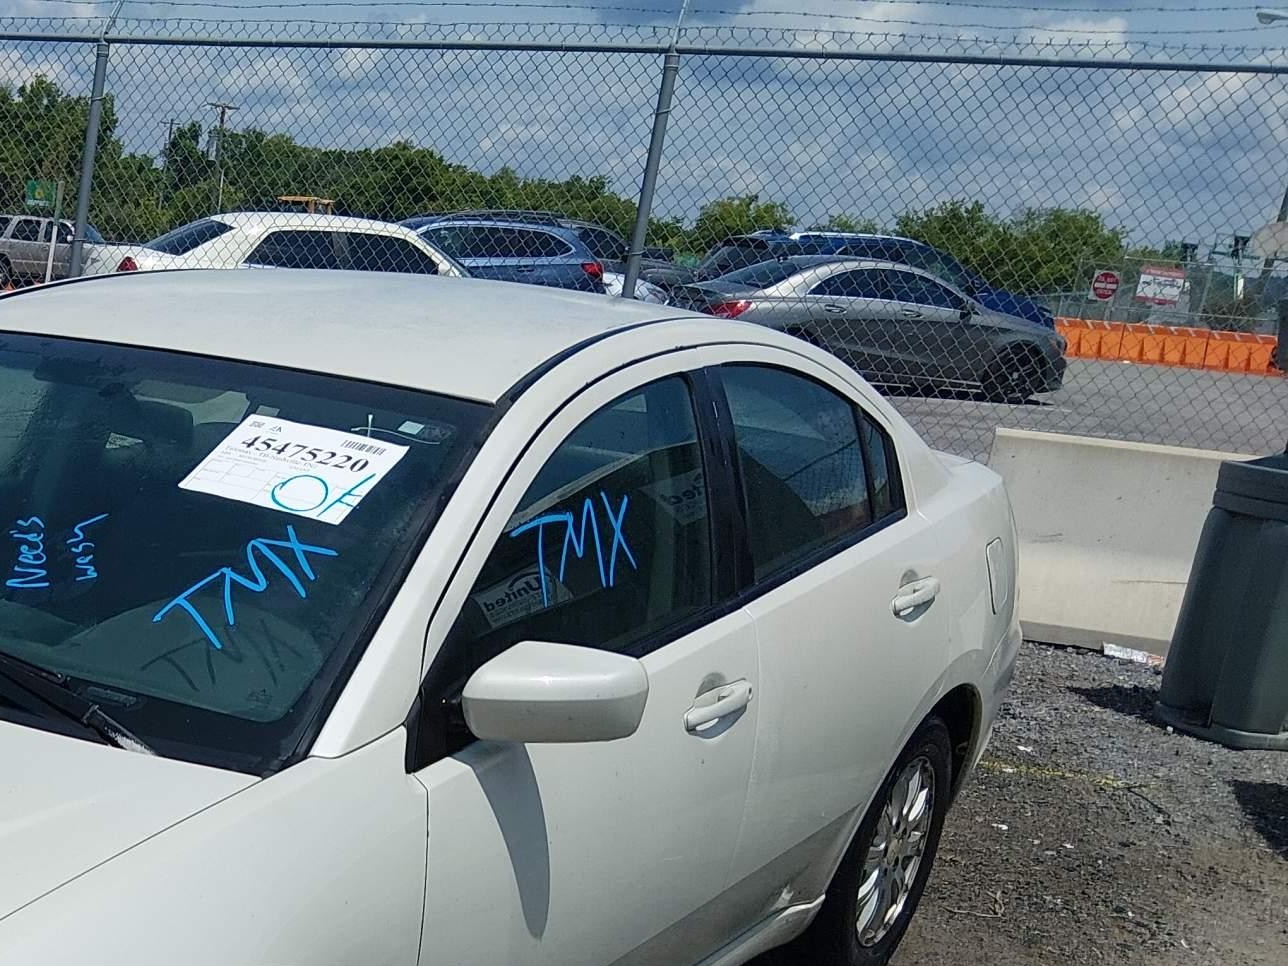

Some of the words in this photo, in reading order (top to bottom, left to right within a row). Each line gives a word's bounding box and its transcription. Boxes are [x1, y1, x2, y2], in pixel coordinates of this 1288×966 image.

[240, 434, 370, 473] 45475220
[152, 525, 339, 649] TMX
[509, 491, 638, 609] TMX
